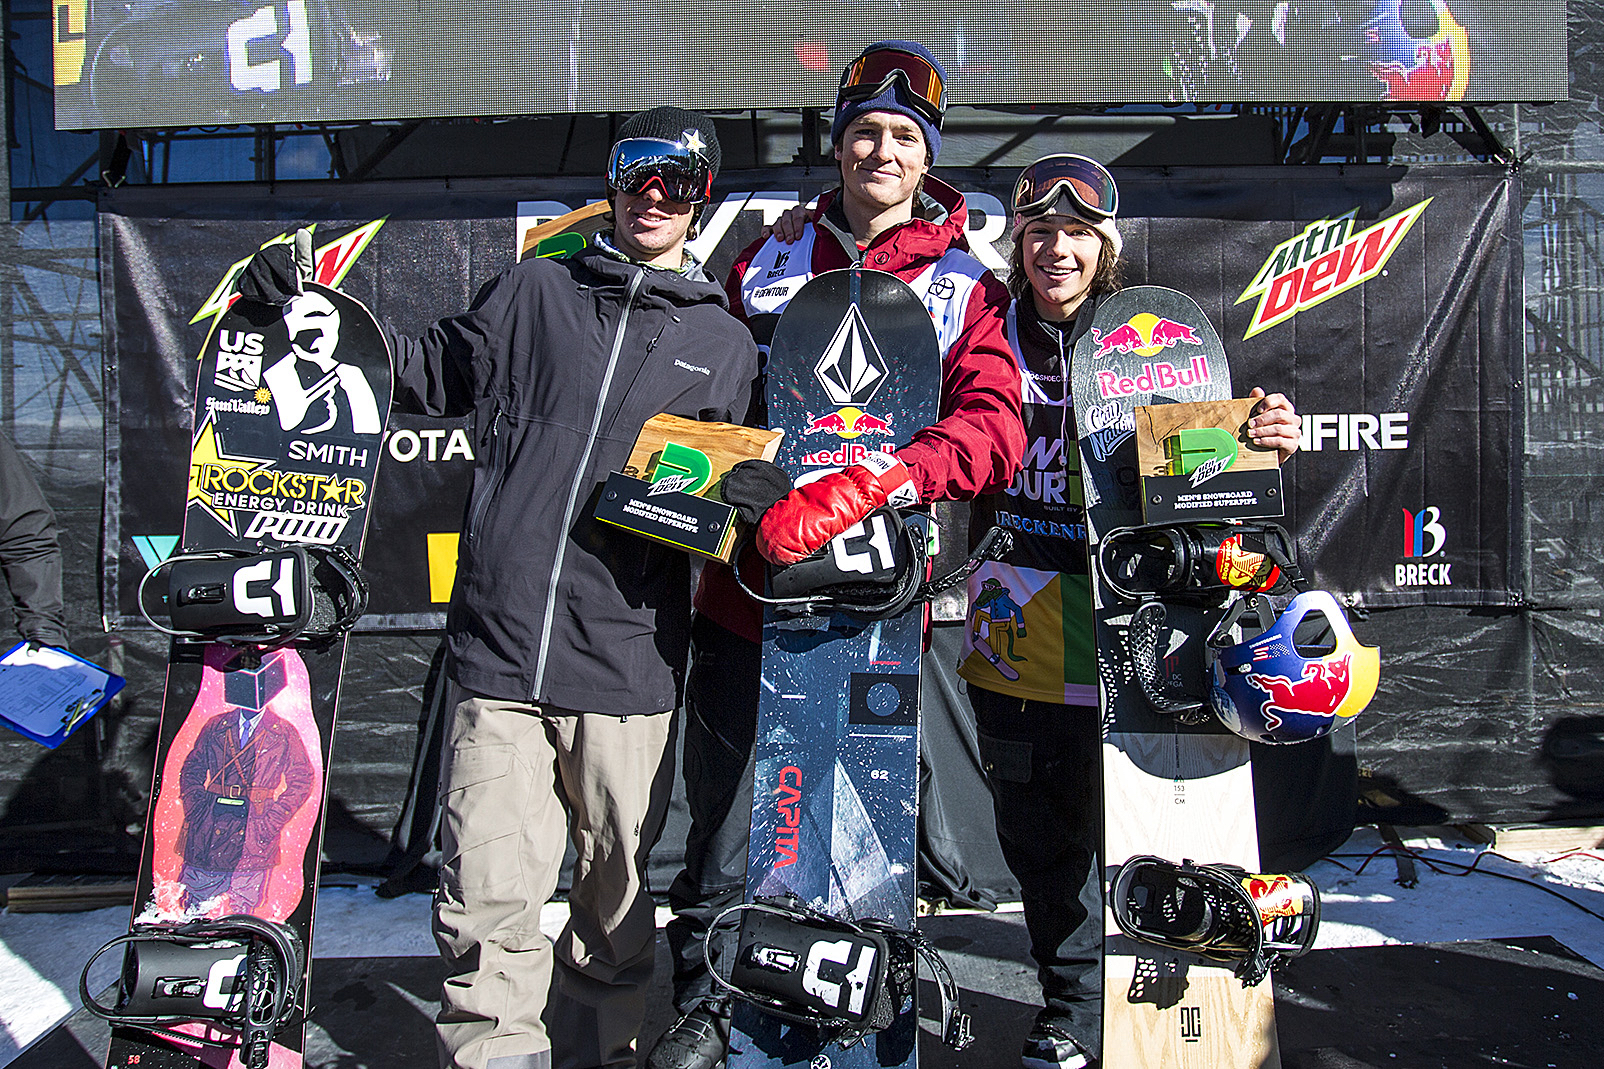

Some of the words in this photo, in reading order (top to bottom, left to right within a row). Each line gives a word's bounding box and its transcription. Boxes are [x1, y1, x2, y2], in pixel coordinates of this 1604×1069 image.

[754, 286, 790, 299] #DEWTOUR
[218, 328, 265, 355] US
[674, 358, 711, 376] patagonia
[1098, 364, 1155, 398] Red
[1156, 356, 1211, 390] Bull
[1299, 412, 1410, 451] NFIRE
[288, 440, 368, 468] SMITH
[383, 428, 475, 462] OTA
[214, 492, 287, 511] ENERGY
[293, 501, 349, 518] DRINK
[1174, 501, 1213, 509] MODIFIED
[1213, 497, 1258, 507] SUPERPIPE
[1177, 494, 1202, 502] MEN'S
[1203, 490, 1253, 500] SNOWBOARD
[622, 504, 659, 521] MODIFIED
[657, 515, 699, 534] SUPERPIPE
[629, 498, 652, 511] MEN'S
[651, 505, 698, 525] SNOWBOARD
[1394, 563, 1453, 587] BRECK
[870, 769, 890, 780] 62
[1174, 784, 1186, 792] 153
[1174, 797, 1186, 805] CM
[127, 1054, 141, 1065] 58
